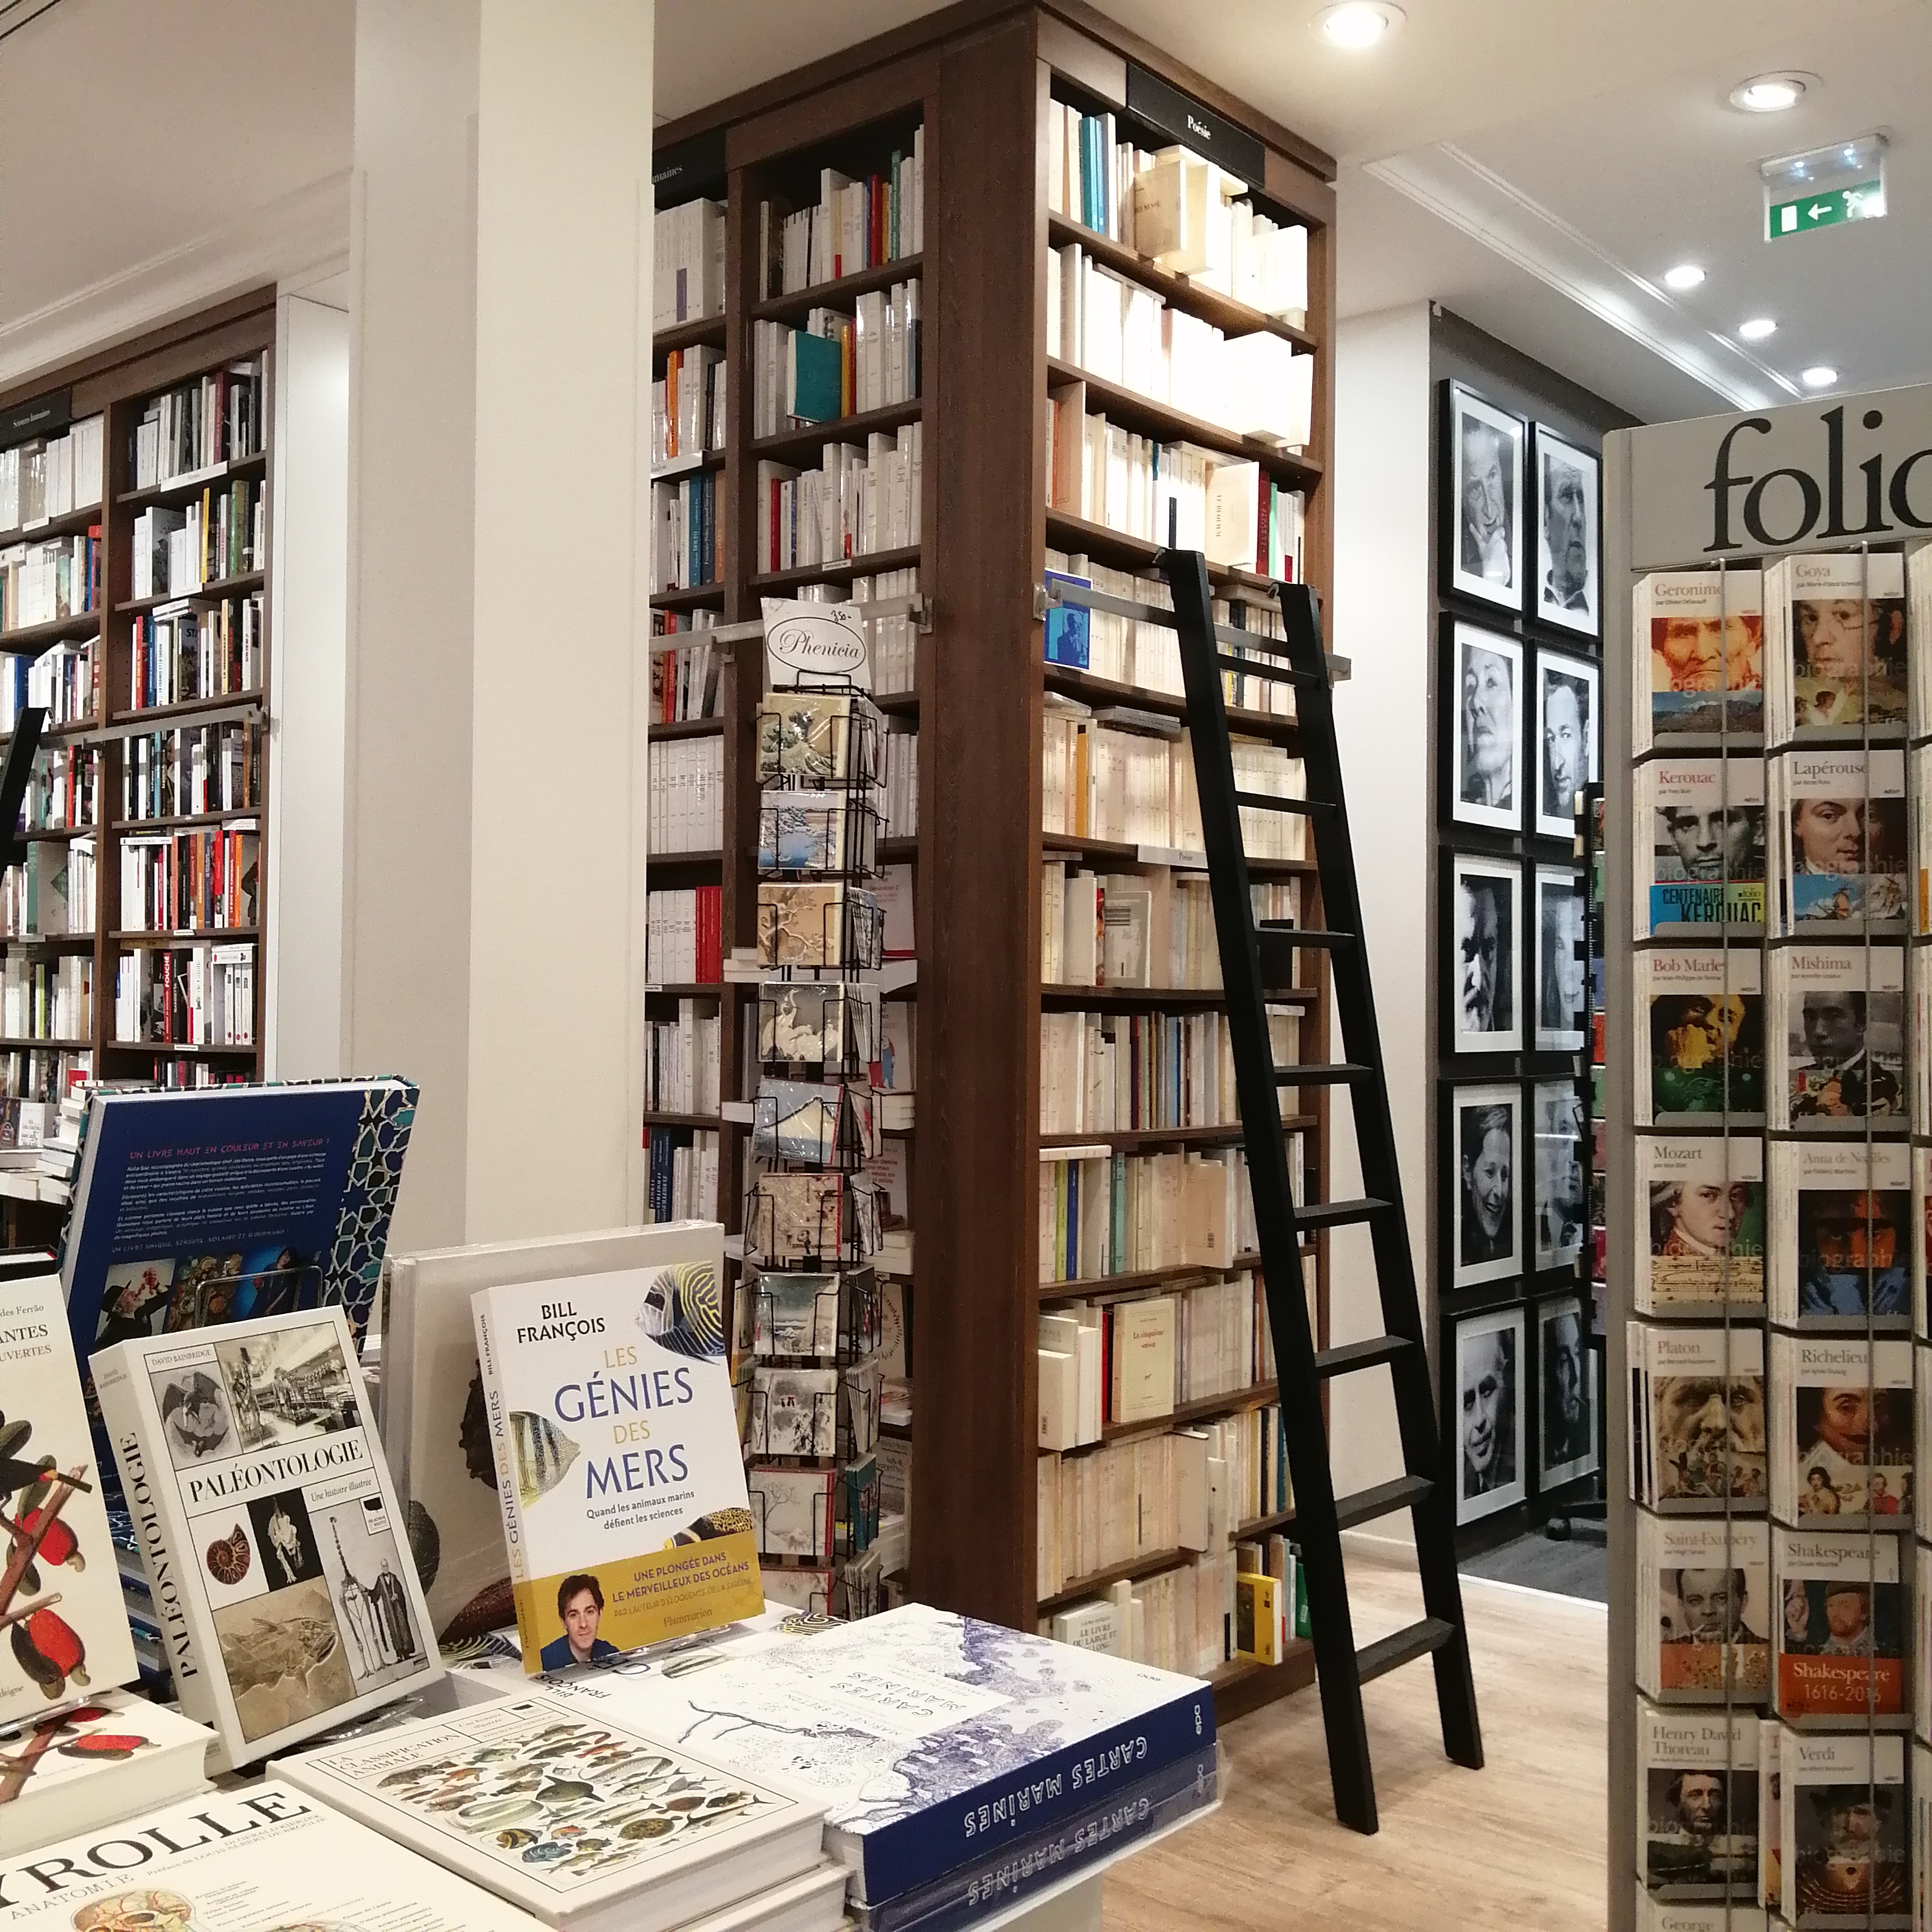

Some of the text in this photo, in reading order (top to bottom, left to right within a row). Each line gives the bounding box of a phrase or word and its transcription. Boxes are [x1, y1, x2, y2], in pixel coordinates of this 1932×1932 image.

[1187, 115, 1212, 140] Poésie
[1703, 406, 1932, 552] folio
[1796, 564, 1831, 581] Goya
[779, 627, 859, 659] Phenicia
[1659, 770, 1716, 785] Kerouac
[1653, 959, 1725, 973] Bob Marle
[1791, 956, 1851, 970] Mishima
[129, 1151, 142, 1160] UN
[147, 1149, 173, 1158] LIVRE
[176, 1147, 201, 1156] HAUT
[204, 1146, 217, 1154] EN
[220, 1141, 259, 1153] COULEUR
[263, 1141, 274, 1150] ET
[277, 1139, 289, 1149] EN
[292, 1139, 323, 1148] SAVEUR
[1654, 1146, 1702, 1159] Mozart
[1804, 1152, 1833, 1164] Anna
[1834, 1152, 1846, 1164] de
[16, 1304, 44, 1314] Ferrão
[541, 1302, 577, 1320] BILL
[480, 1314, 490, 1357] FRANÇOIS
[516, 1317, 606, 1343] FRANÇOIS
[151, 1349, 212, 1366] DAVID BAINBRIDGE
[604, 1346, 638, 1368] LES
[1657, 1341, 1700, 1354] Platon
[1802, 1349, 1868, 1364] Richelieu
[554, 1367, 693, 1422] GÉNIES
[613, 1420, 650, 1445] DES
[188, 1439, 363, 1503] PALÉONTOLOGIE
[586, 1444, 689, 1499] MERS
[311, 1478, 372, 1502] Une histoire illustrée
[490, 1390, 523, 1578] LES GÉNIES DES MERS
[586, 1490, 695, 1519] Quand les animaux marins
[604, 1507, 684, 1530] défient les sciences
[120, 1432, 198, 1679] PALÉONTOLOGIE
[633, 1552, 726, 1582] UNE PLONGÉE DANS
[612, 1561, 749, 1603] LE MERVEILLEUX DES OCÉANS
[614, 1609, 628, 1617] PAR
[663, 1609, 712, 1627] Flammarion
[1080, 1624, 1111, 1637] LE LIVRE
[534, 1674, 612, 1699] FRANÇOIS
[545, 1686, 574, 1698] BILL
[846, 1671, 967, 1711] MARINES
[830, 1682, 934, 1717] CARTES
[850, 1716, 903, 1736] MARINE
[1653, 1726, 1741, 1743] Henry Davd
[339, 1732, 461, 1771] CLASSIFICATION
[1654, 1741, 1710, 1756] Thoreau
[1799, 1746, 1835, 1760] Verdi
[352, 1751, 424, 1777] ANIMALE
[964, 1736, 1148, 1838] CARTES MARINES
[968, 1797, 1150, 1906] CARTES MARINES
[11, 1873, 135, 1920] ANATOMIE
